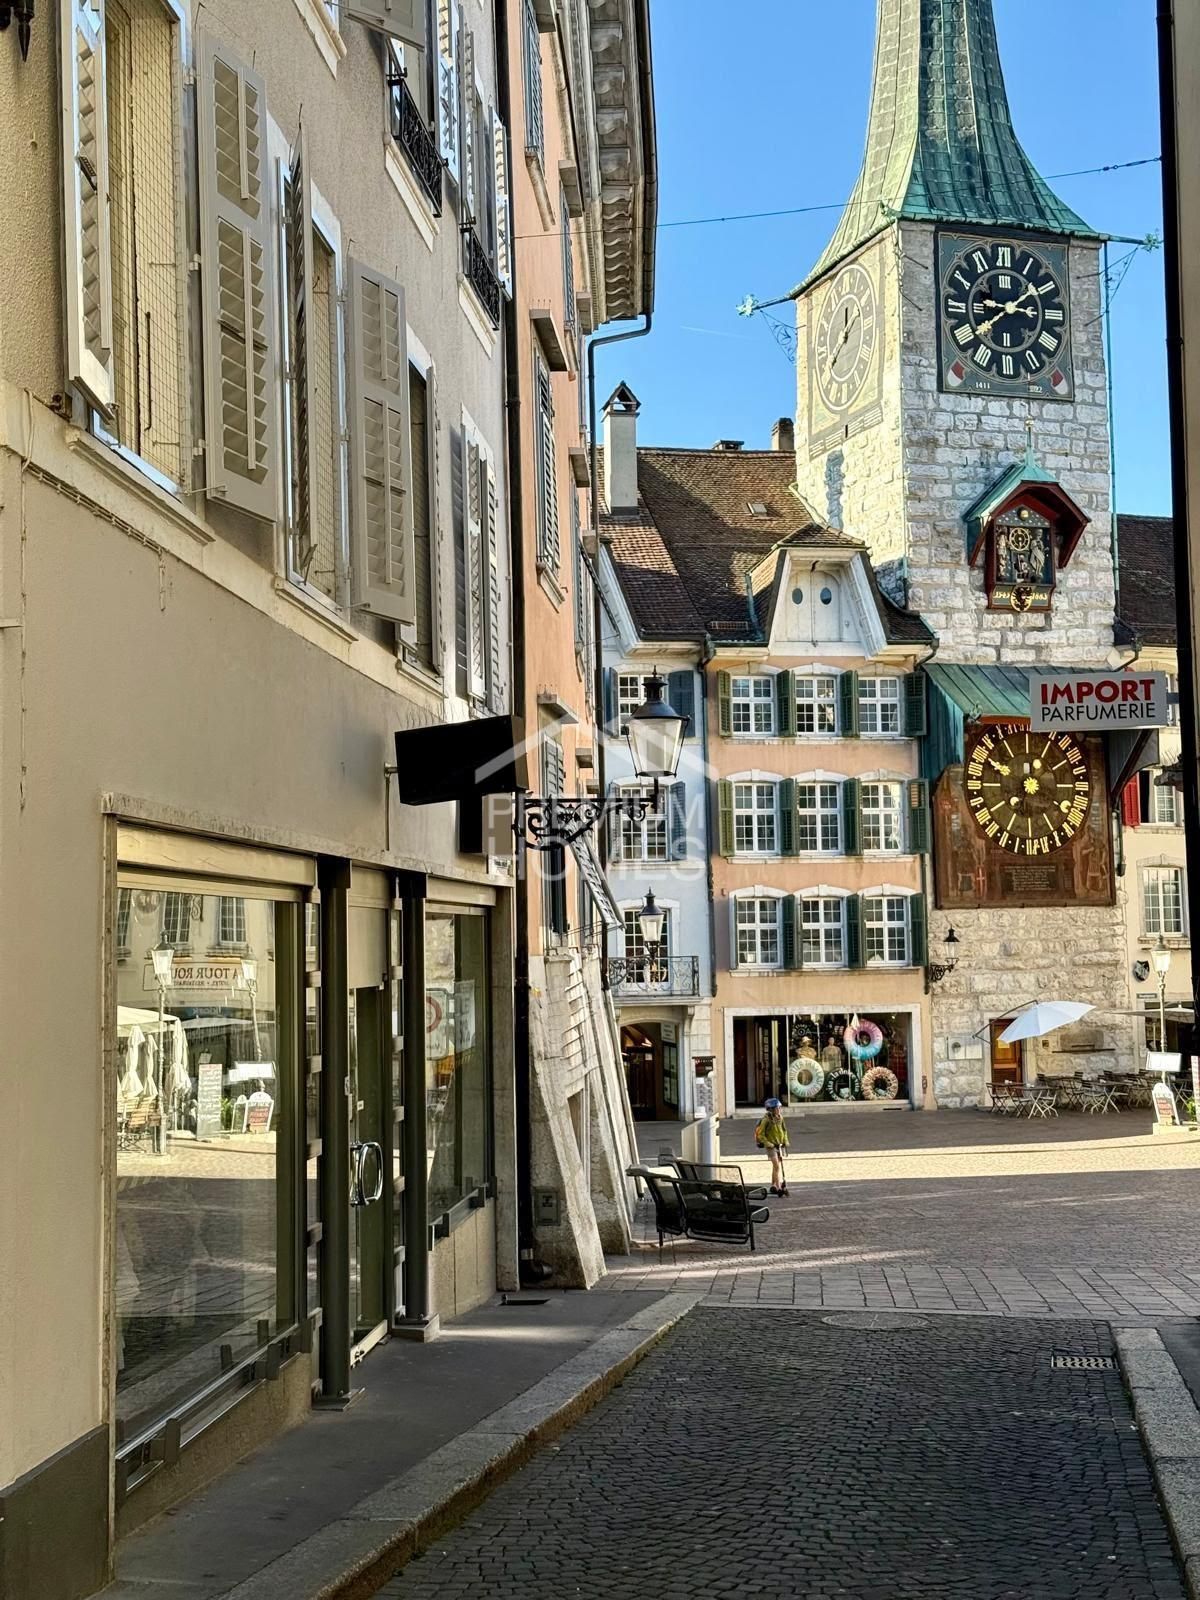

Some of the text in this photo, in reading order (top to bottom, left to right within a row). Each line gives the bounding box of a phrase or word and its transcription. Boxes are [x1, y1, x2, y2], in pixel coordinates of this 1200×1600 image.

[972, 251, 989, 274] XI
[996, 247, 1011, 267] XII
[954, 271, 971, 290] X
[1045, 309, 1063, 321] III
[1041, 679, 1155, 705] IMPORT
[1042, 703, 1156, 722] PARFUMERIE
